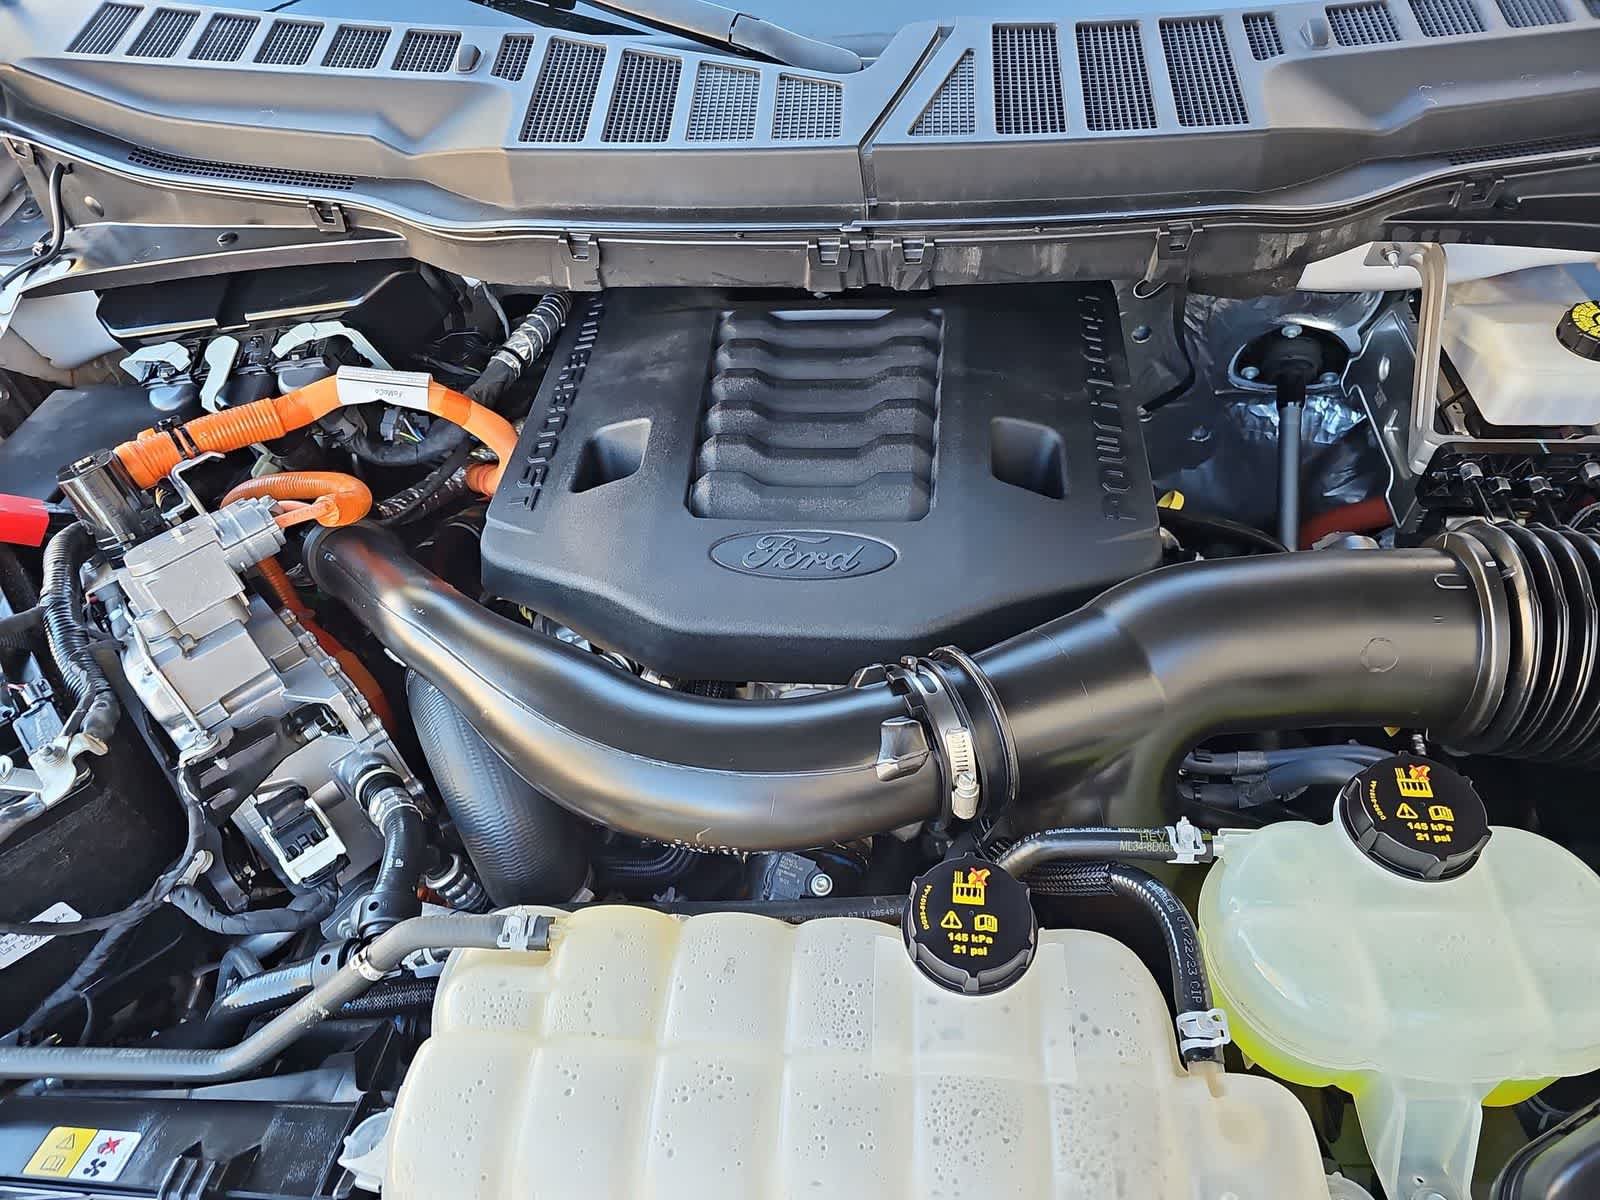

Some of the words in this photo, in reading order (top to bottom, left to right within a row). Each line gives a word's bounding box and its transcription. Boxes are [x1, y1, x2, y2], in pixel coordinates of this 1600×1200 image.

[742, 534, 865, 572] Ford
[1407, 822, 1428, 831] 145
[1430, 823, 1454, 832] kPa
[1139, 832, 1166, 842] HEV
[1415, 833, 1430, 841] 21
[1433, 834, 1452, 843] psi
[948, 932, 969, 942] 145
[971, 934, 994, 944] kPa
[952, 944, 967, 954] 21
[970, 946, 988, 957] psi
